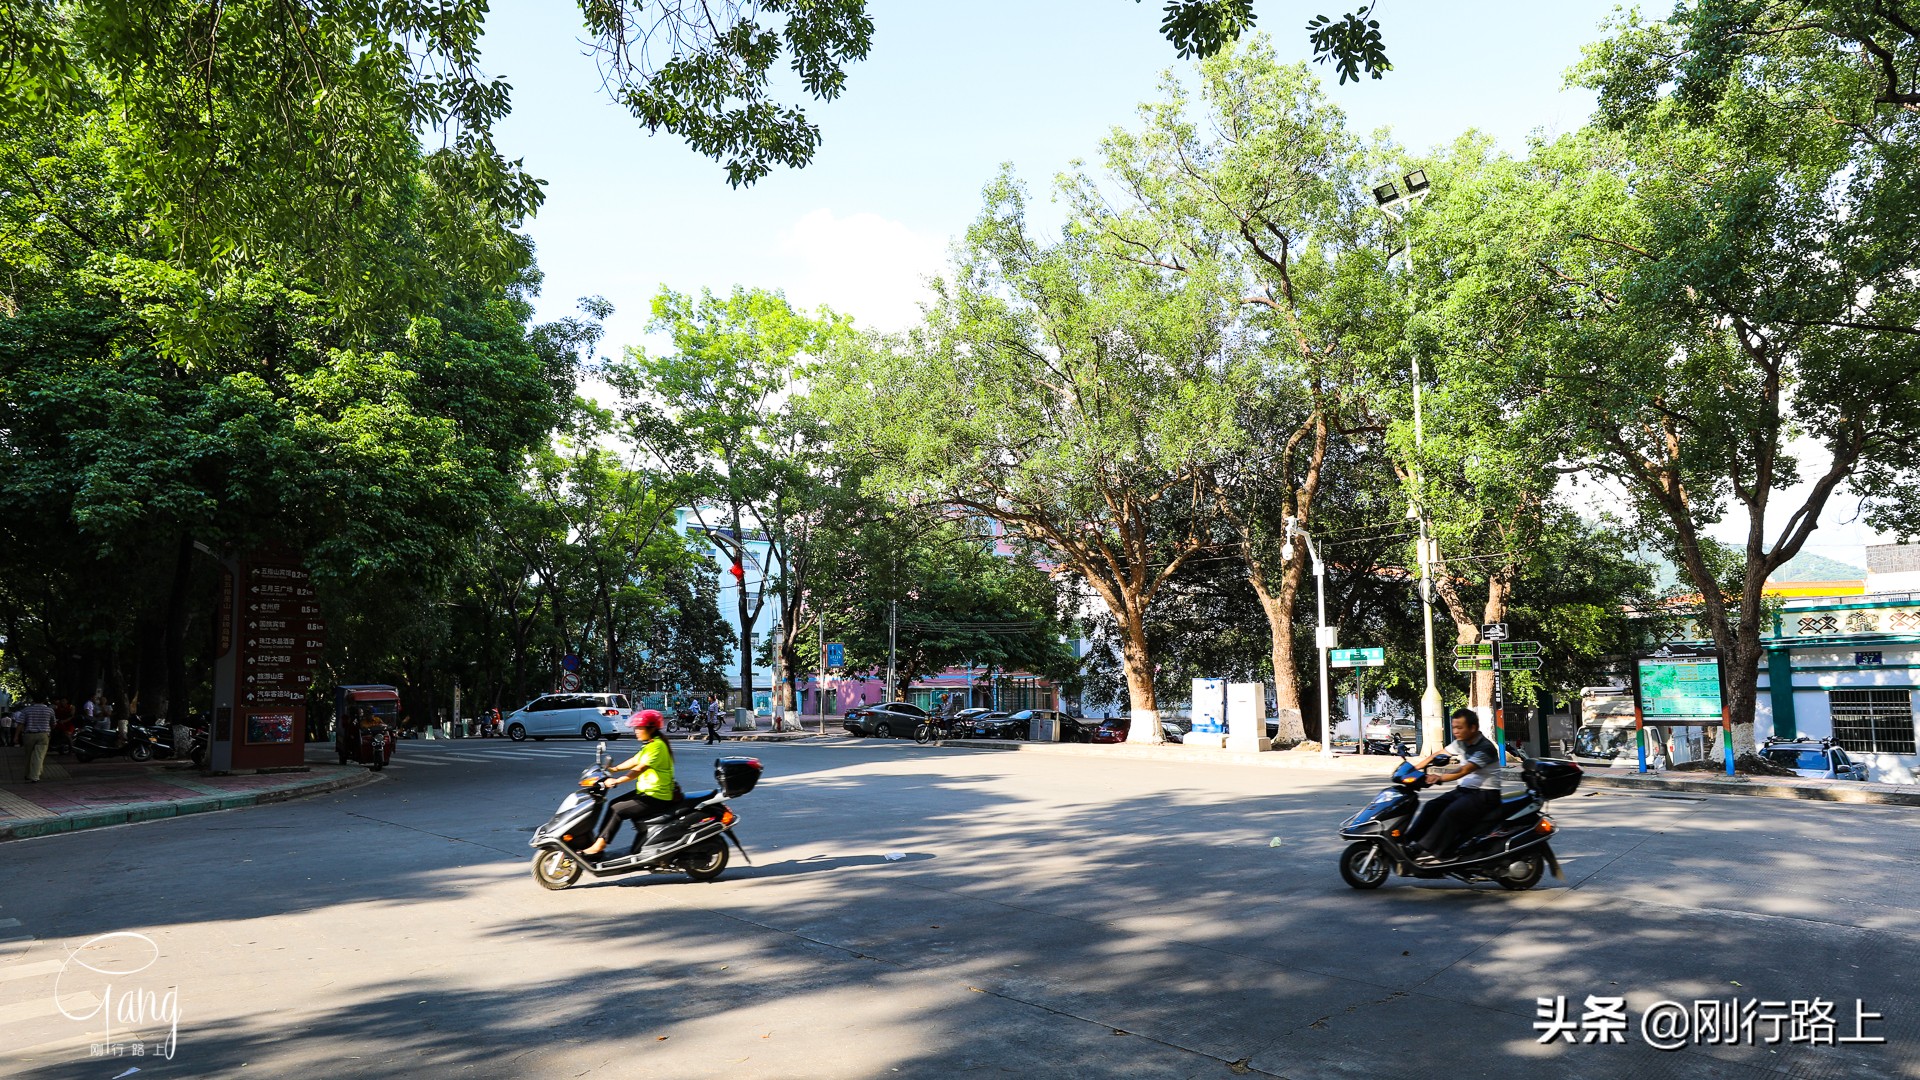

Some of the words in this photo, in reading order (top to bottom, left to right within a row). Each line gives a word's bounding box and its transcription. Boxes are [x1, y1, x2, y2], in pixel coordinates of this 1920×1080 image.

[261, 567, 291, 576] 五指山宾馆
[260, 584, 293, 593] 三月三广场
[260, 603, 280, 611] 老州府
